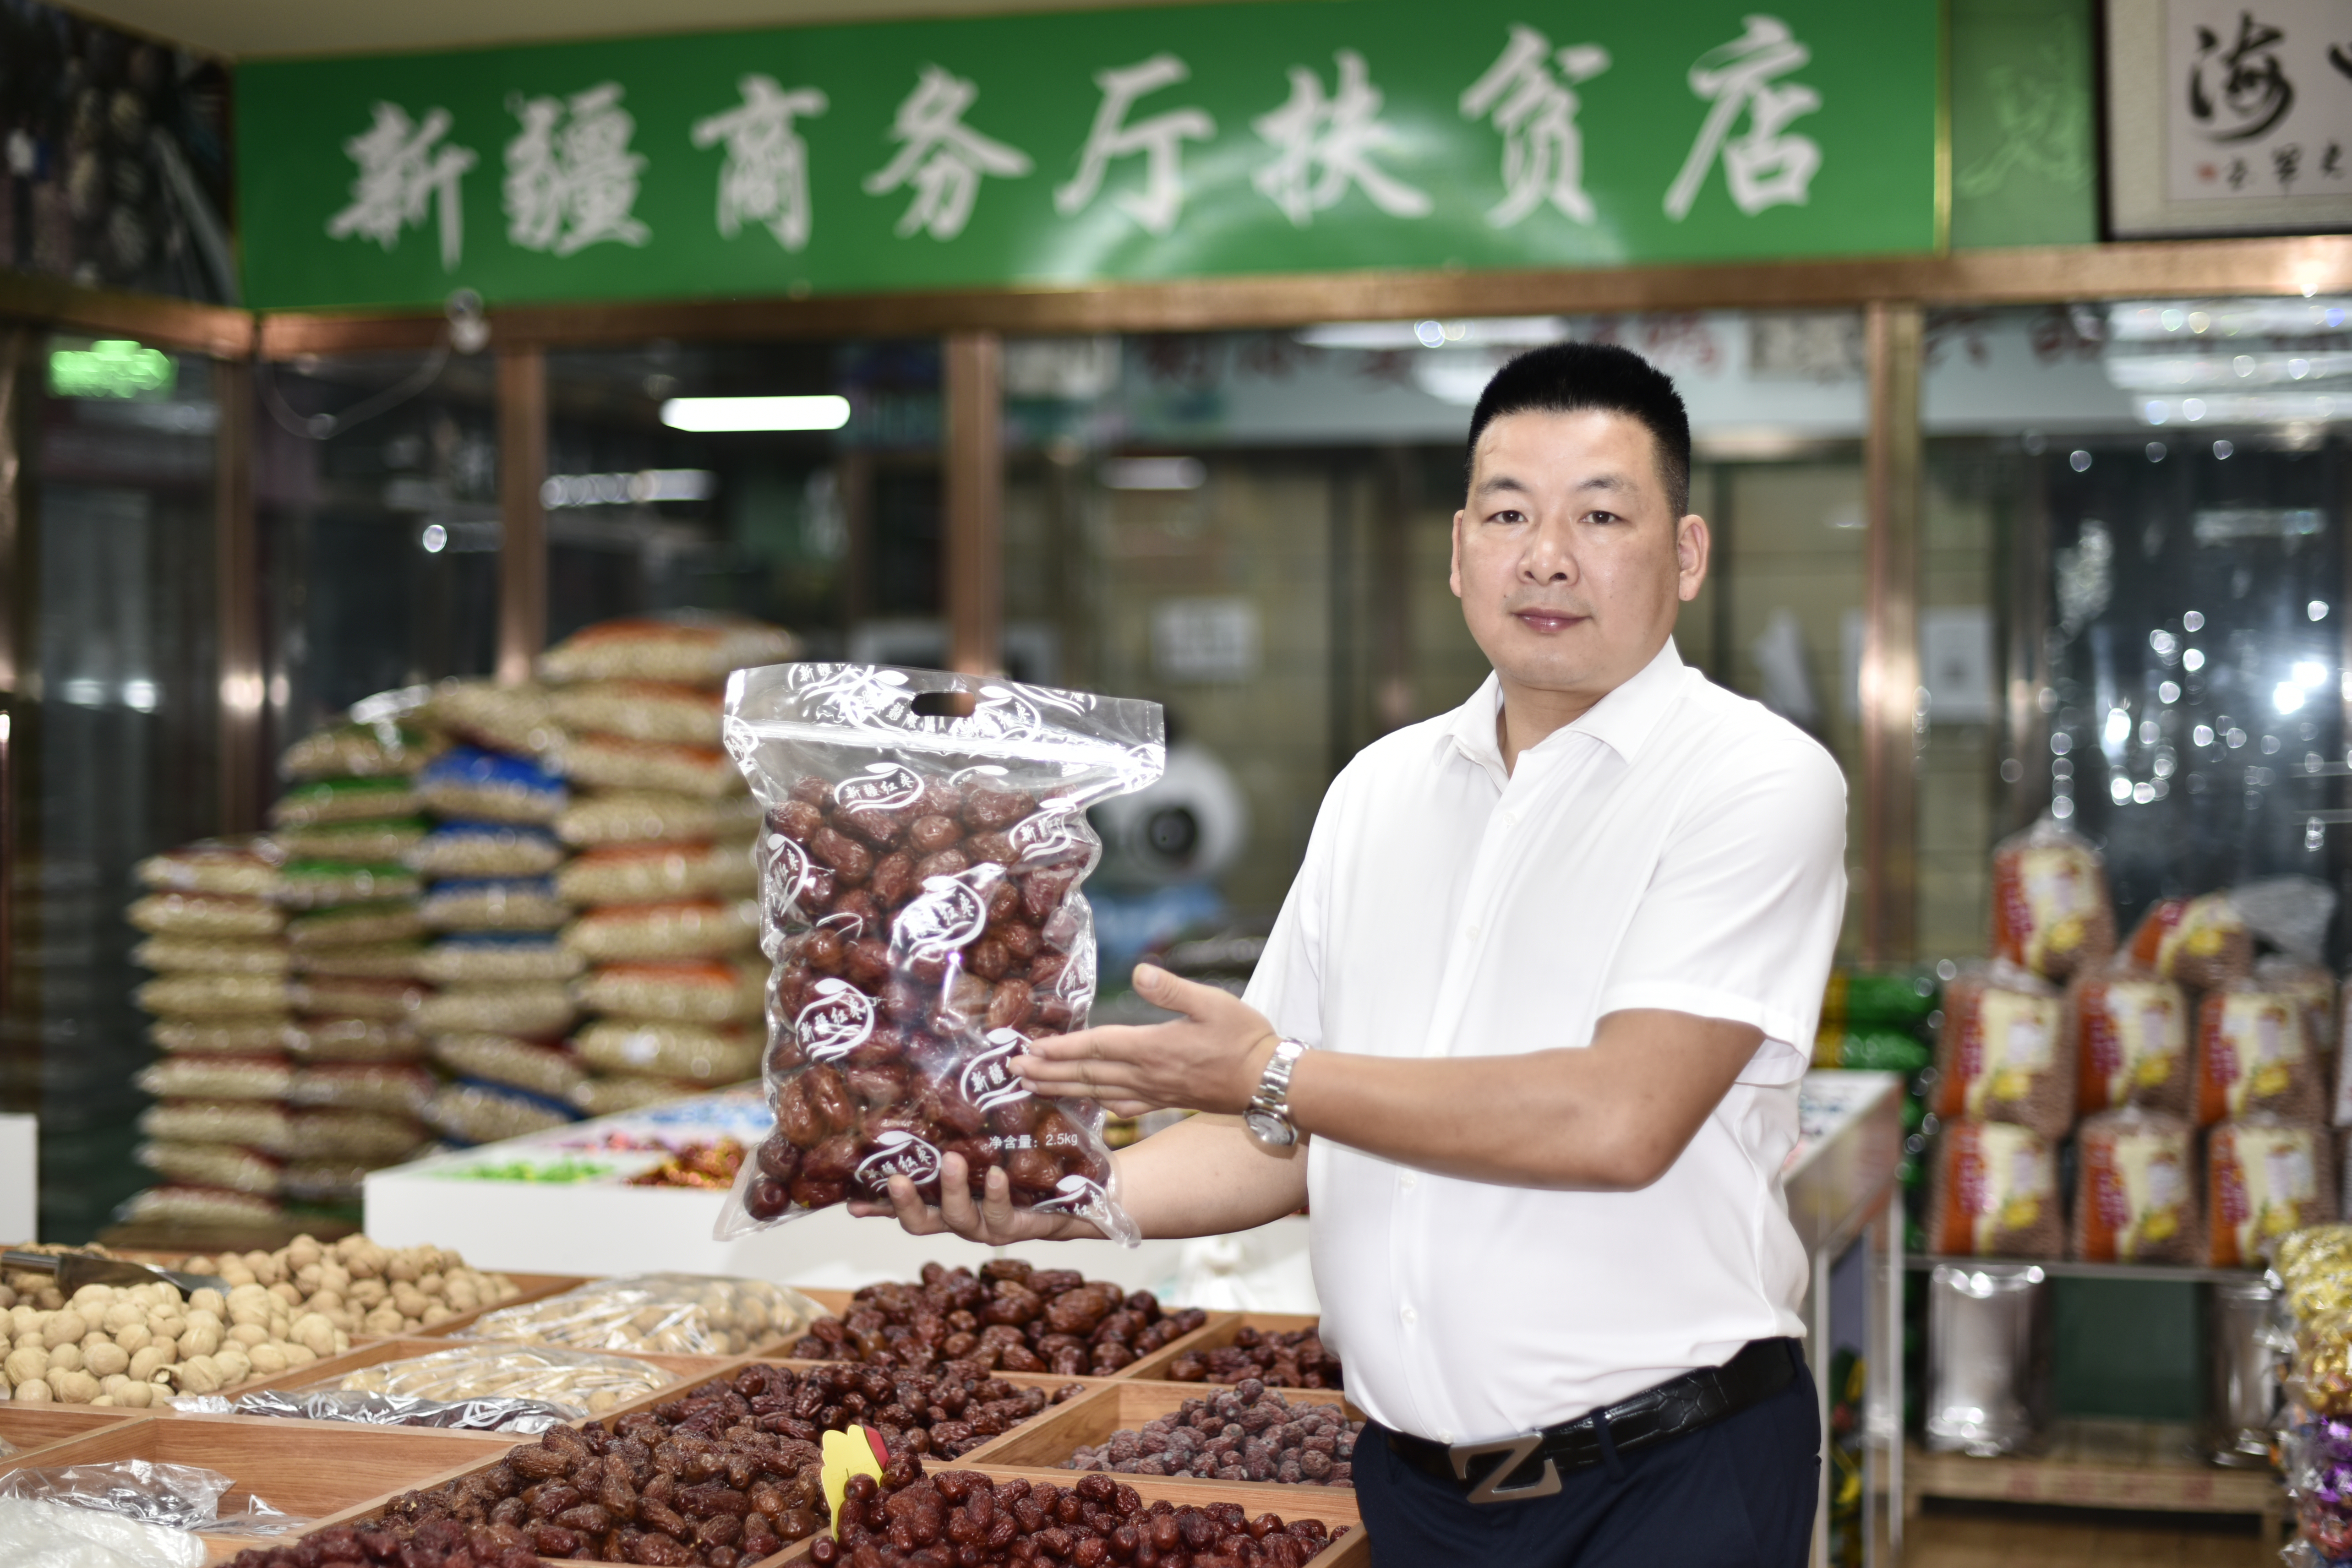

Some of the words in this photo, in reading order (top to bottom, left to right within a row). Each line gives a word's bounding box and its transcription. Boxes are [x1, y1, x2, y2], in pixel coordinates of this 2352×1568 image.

[325, 15, 1824, 272] 新疆商务厅扶贫店
[845, 772, 914, 800] 新疆红枣
[971, 1044, 1030, 1093] 新疆
[1046, 1132, 1078, 1146] 2.5kg
